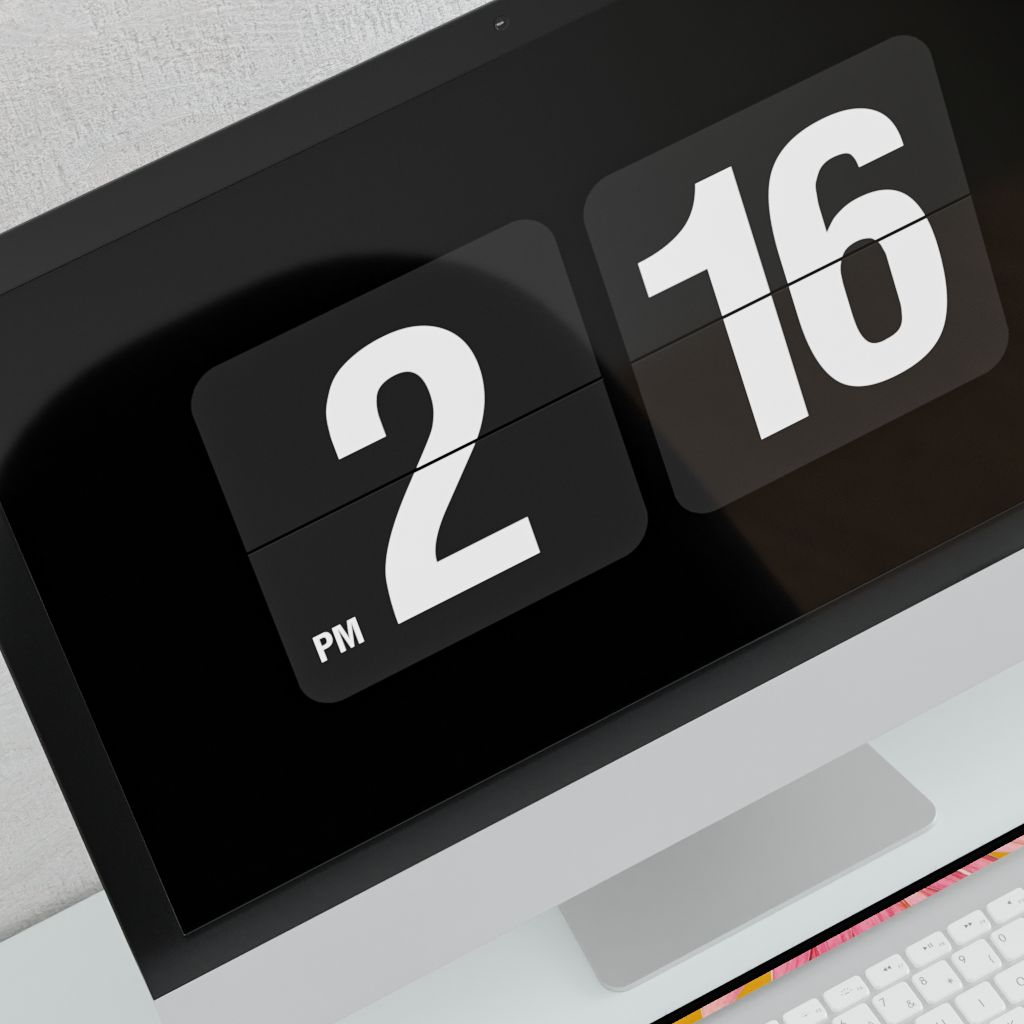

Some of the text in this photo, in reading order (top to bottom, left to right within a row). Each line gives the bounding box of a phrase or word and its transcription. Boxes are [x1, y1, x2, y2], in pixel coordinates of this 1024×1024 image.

[325, 108, 947, 625] 2 16
[312, 617, 364, 663] PM
[957, 954, 967, 965] 9
[918, 976, 928, 986] 8
[878, 997, 886, 1008] 7
